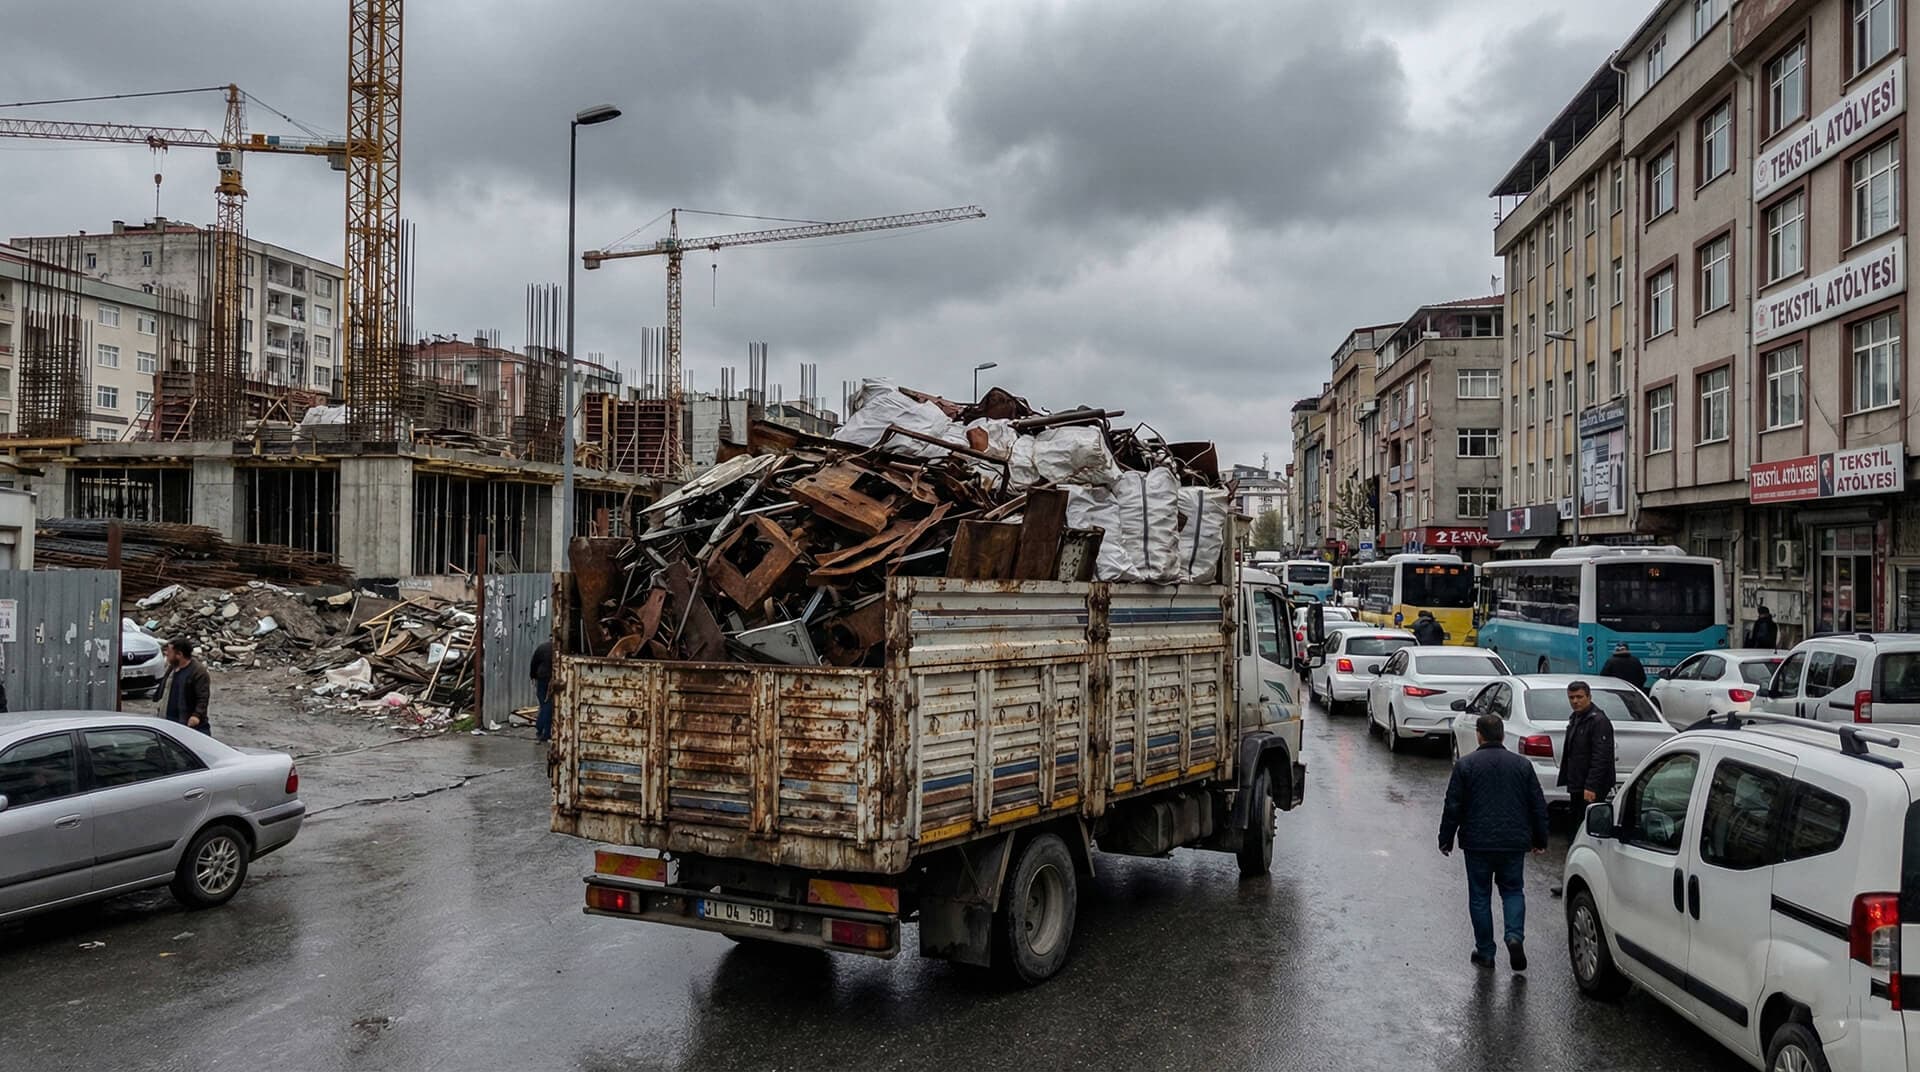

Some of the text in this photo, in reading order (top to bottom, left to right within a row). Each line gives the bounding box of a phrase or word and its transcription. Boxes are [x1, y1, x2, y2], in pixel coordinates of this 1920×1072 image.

[1771, 69, 1896, 182] TEKSTİL ATÖLYESİ
[1770, 247, 1896, 328] TEKSTİL ATÖLYESİ
[1840, 447, 1892, 471] TEKSTİL
[1752, 461, 1817, 488] TEKSTİL ATÖLYESİ
[1837, 467, 1897, 492] ATÖLYESİ
